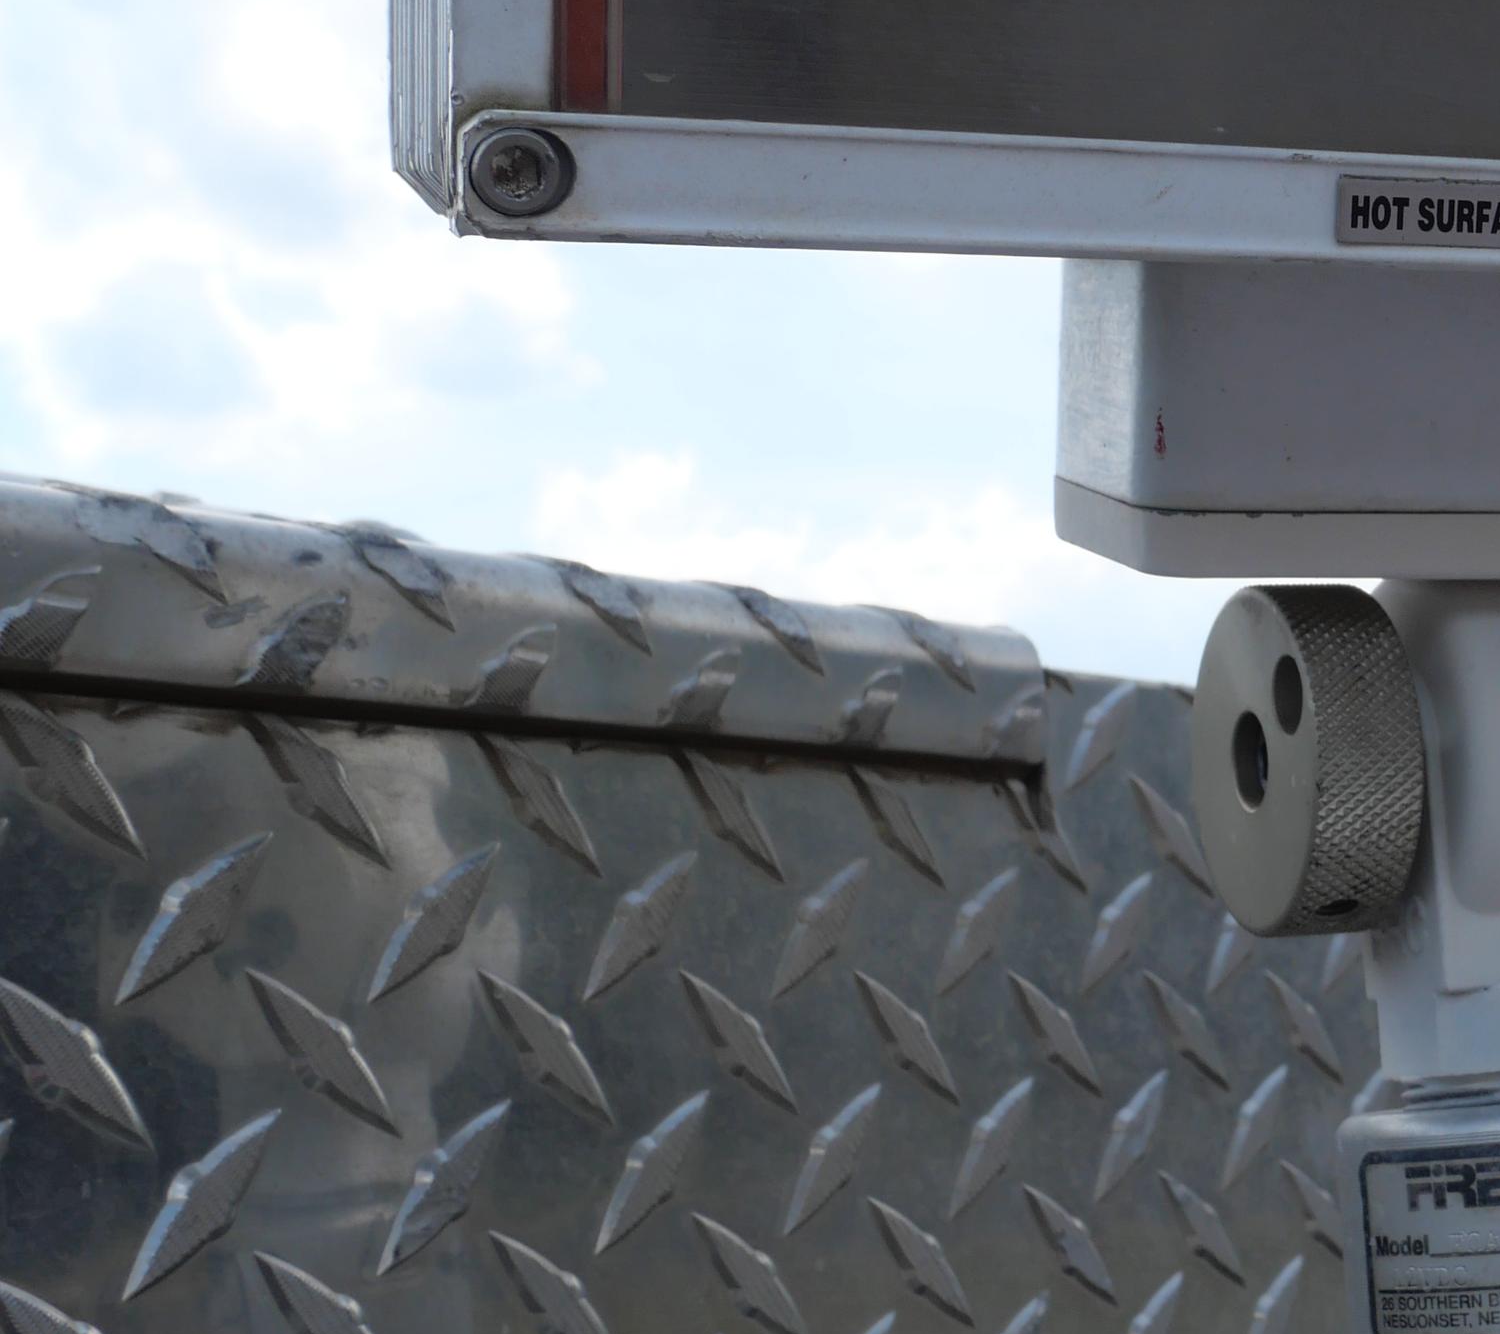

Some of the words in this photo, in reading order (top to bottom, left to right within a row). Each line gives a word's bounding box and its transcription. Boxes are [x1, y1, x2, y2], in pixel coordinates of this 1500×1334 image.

[1350, 195, 1410, 230] HOT
[1375, 1236, 1430, 1258] Model
[1381, 1298, 1395, 1312] 26
[1398, 1293, 1483, 1310] SOUTHERN
